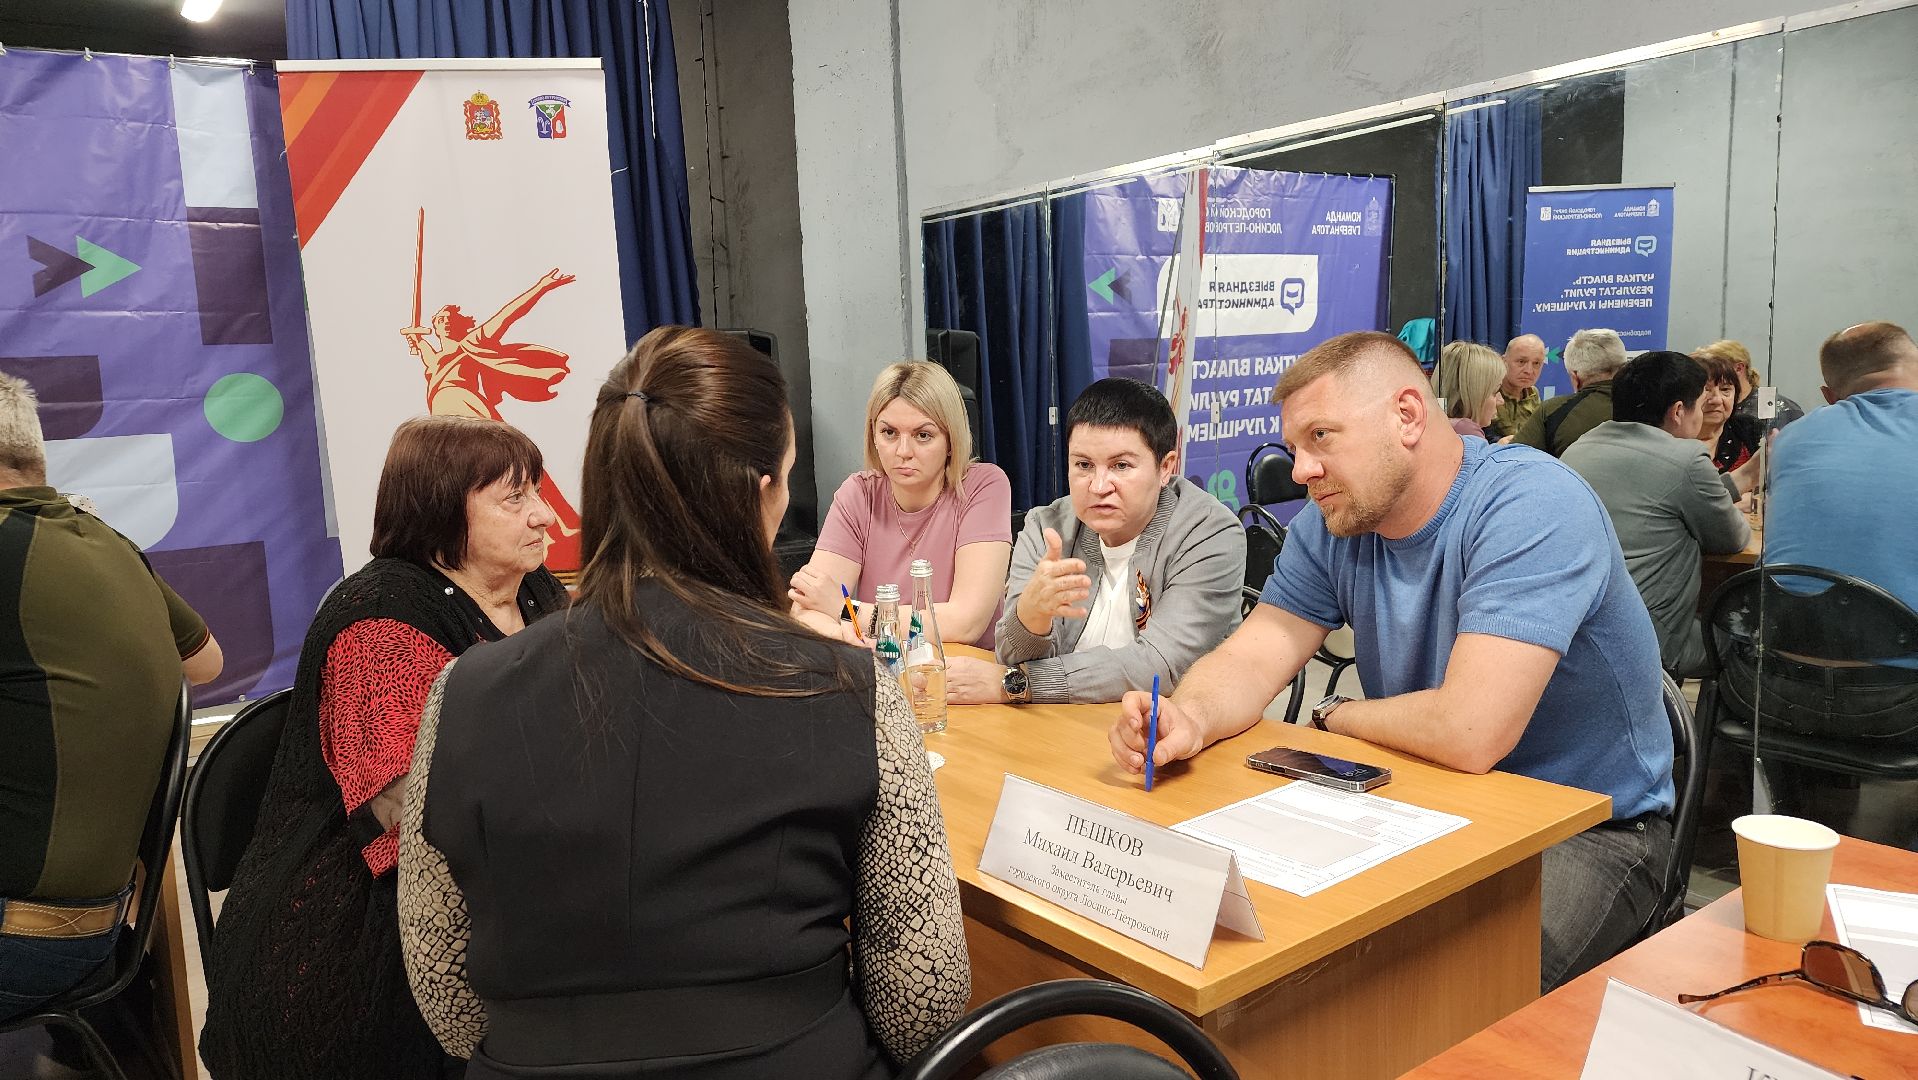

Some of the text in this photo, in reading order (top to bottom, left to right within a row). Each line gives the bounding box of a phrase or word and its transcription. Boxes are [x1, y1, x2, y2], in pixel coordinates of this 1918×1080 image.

[1022, 826, 1080, 865] Михаил
[1080, 850, 1176, 904] Валерьевич
[1064, 813, 1145, 858] ПЕШКОВ
[1007, 865, 1171, 943] городского округа Лосино-Петровский
[1049, 864, 1129, 906] Заместитель главы
